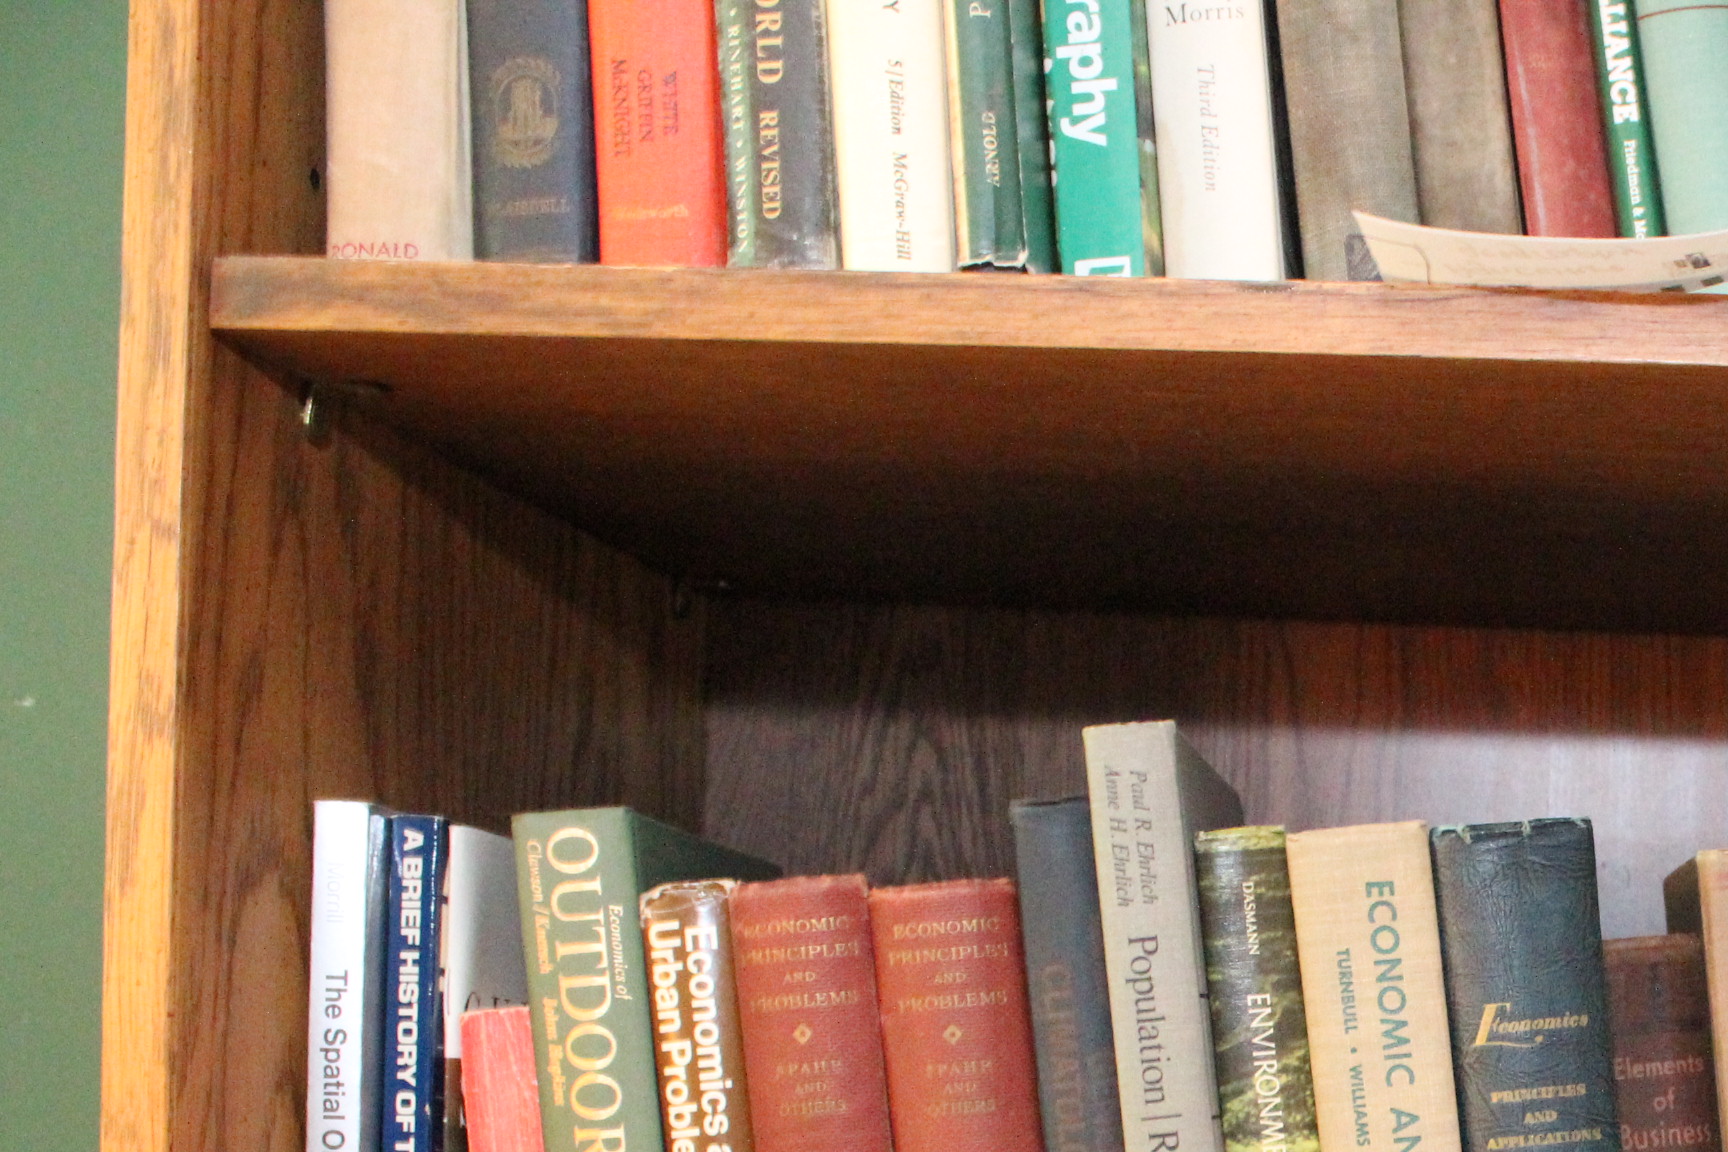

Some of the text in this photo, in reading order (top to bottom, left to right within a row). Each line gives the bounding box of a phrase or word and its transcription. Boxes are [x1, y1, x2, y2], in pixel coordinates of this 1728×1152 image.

[1165, 3, 1245, 27] Morris
[727, 23, 751, 253] RINEHART WINSTON
[759, 111, 783, 220] REVISED
[981, 111, 1001, 188] ARNOLD
[1197, 64, 1220, 192] Third Edition
[891, 151, 914, 261] McGraw-Hill
[1624, 139, 1643, 205] Friedman
[330, 242, 419, 260] RONALD
[402, 829, 425, 850] A
[1103, 765, 1131, 908] Anne Ehrlich
[1130, 769, 1162, 905] Paul Ehrlich
[400, 855, 424, 946] BRIEF
[744, 916, 850, 940] ECONOMIC
[893, 916, 1000, 941] ECONOMIC
[1241, 881, 1260, 957] DASMANN
[608, 903, 634, 1001] Economics of
[647, 920, 686, 1034] Urban
[1365, 880, 1416, 1088] ECONOMIC
[324, 969, 348, 1020] The
[396, 950, 421, 1088] HISTORY
[684, 924, 734, 1138] Economics
[1125, 934, 1172, 1105] Population
[319, 1032, 348, 1120] Spatial
[1336, 947, 1355, 1035] TURNBULL
[1349, 1064, 1370, 1147] WILLIAMS
[1613, 1056, 1704, 1081] Elements
[394, 1089, 418, 1137] OF
[1487, 1127, 1601, 1151] APPLICATIONS
[1524, 1110, 1558, 1124] AND
[1620, 1123, 1712, 1152] Business
[1653, 1091, 1676, 1112] of
